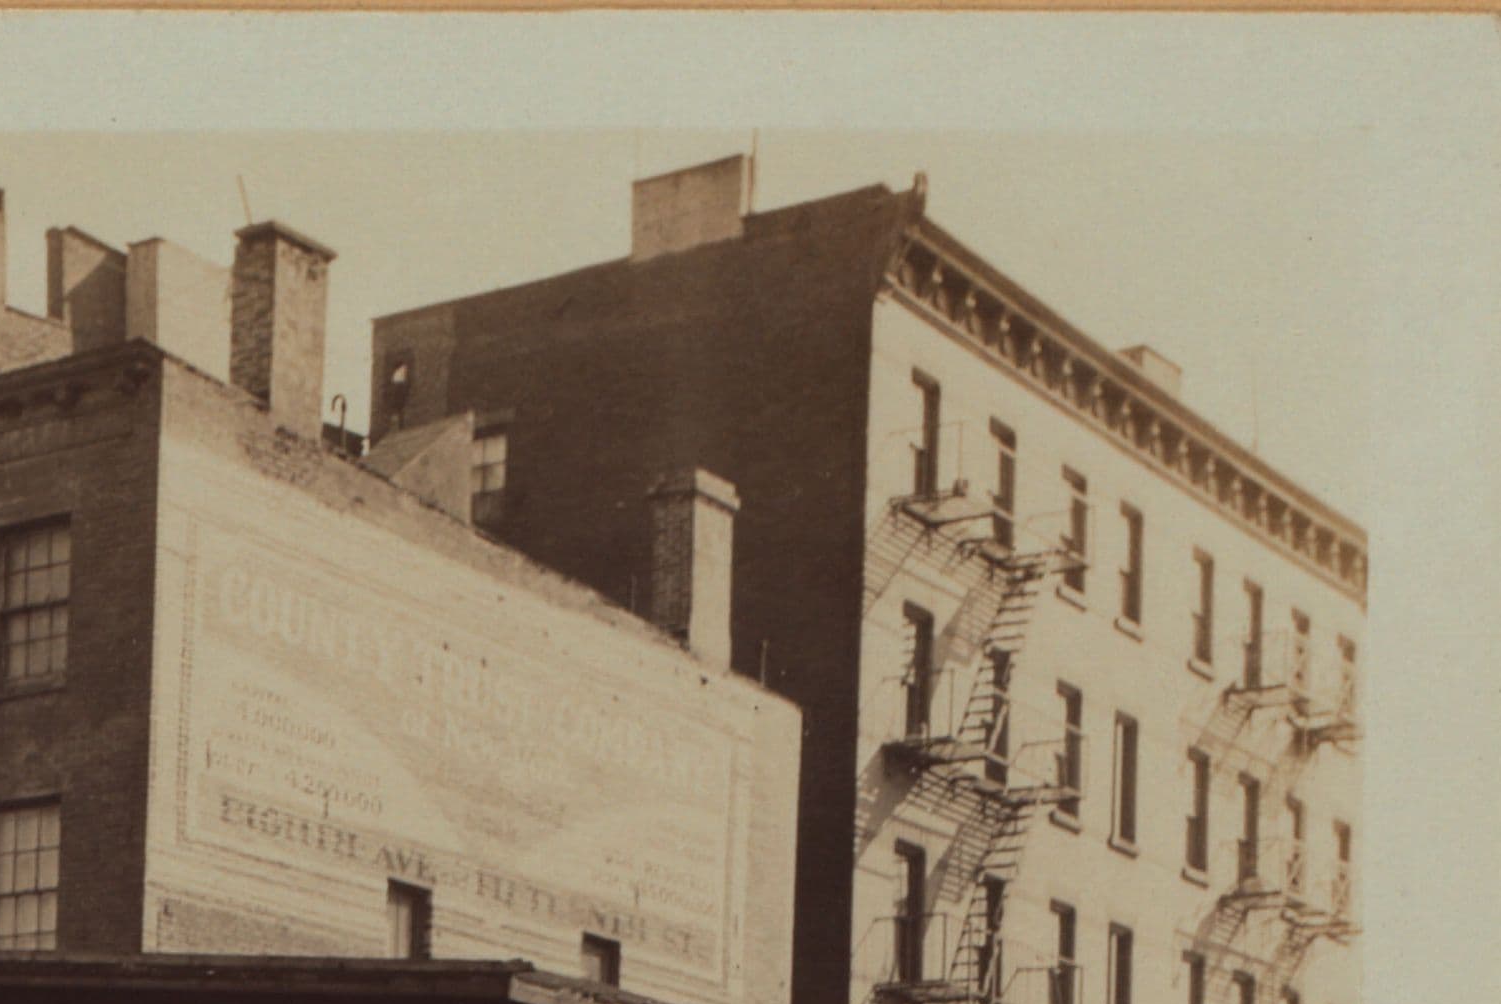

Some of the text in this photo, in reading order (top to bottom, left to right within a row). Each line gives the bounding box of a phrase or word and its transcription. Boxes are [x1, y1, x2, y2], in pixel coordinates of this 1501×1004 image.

[220, 563, 395, 683] COUNTY
[416, 639, 537, 736] TRUST
[219, 793, 358, 861] EIGHTH
